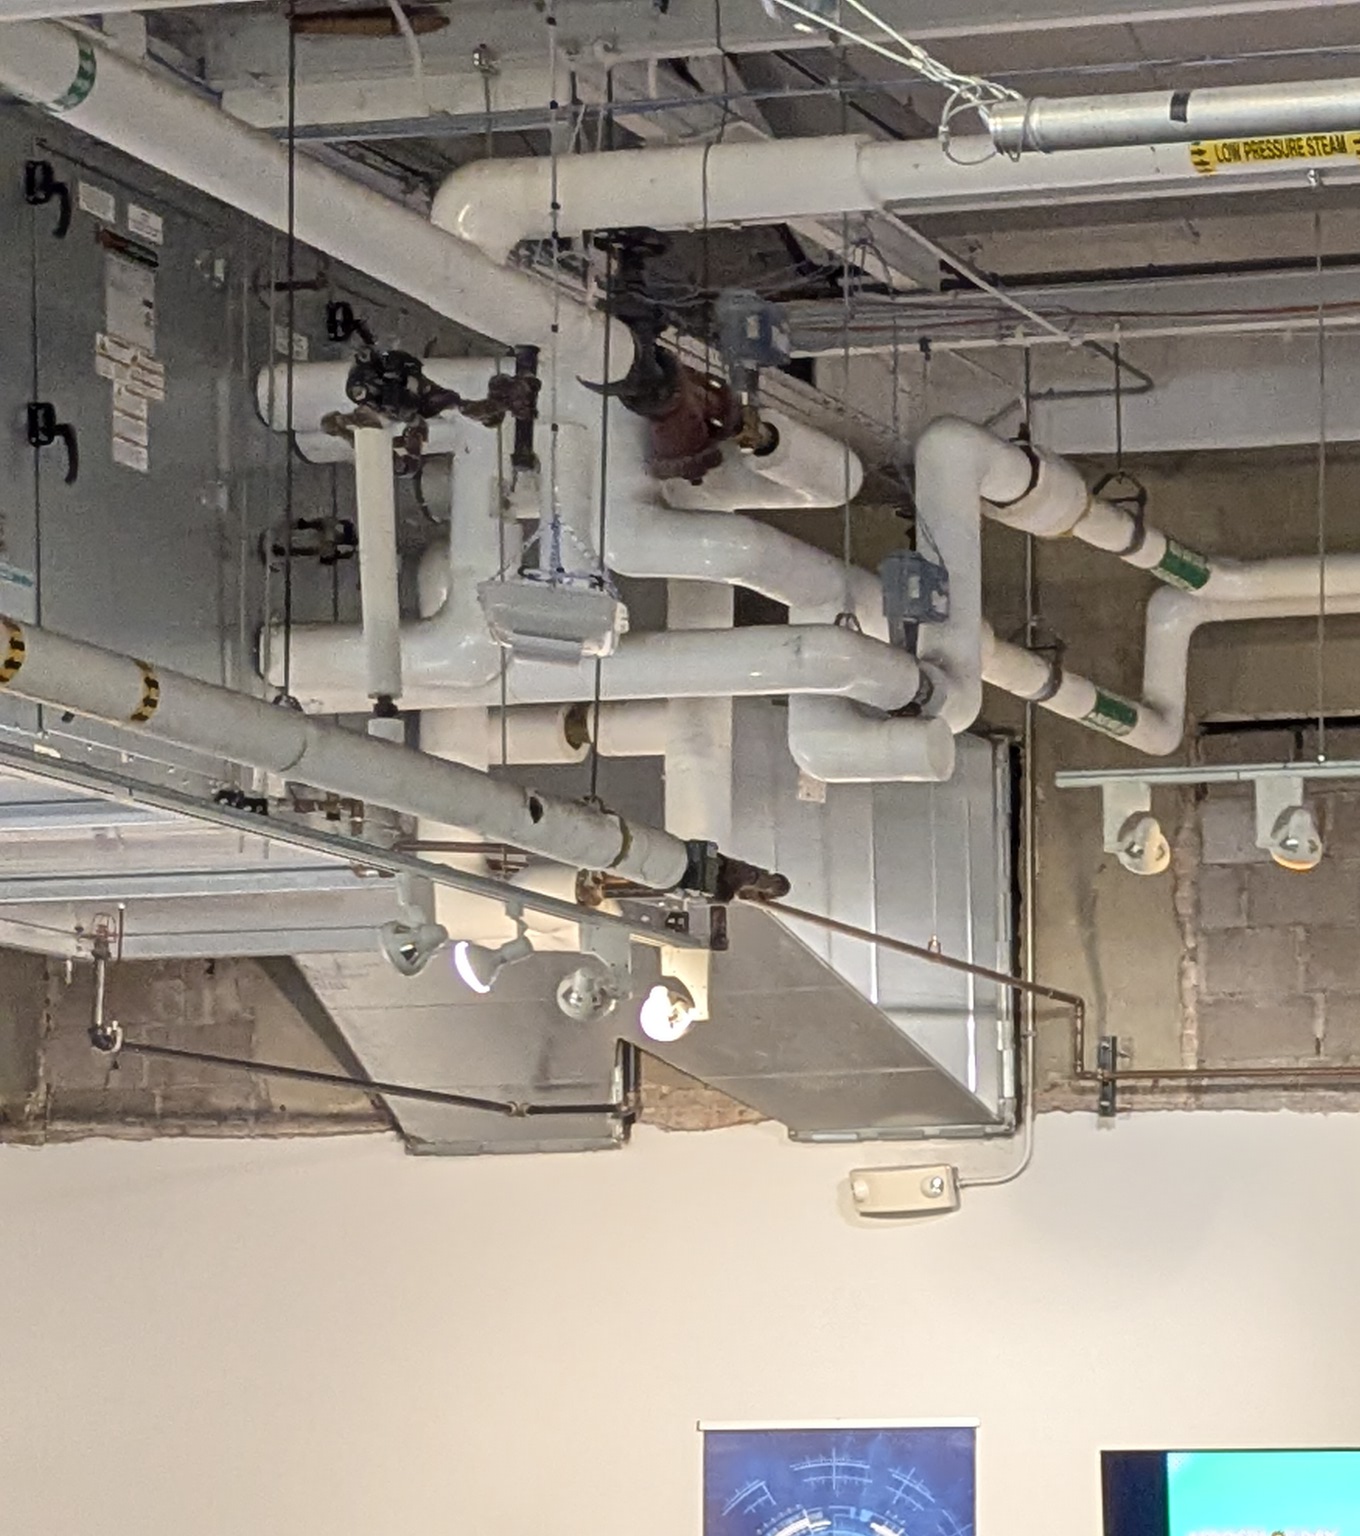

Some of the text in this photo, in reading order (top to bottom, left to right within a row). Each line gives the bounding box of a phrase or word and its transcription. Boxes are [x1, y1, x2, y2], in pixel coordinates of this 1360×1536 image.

[1214, 134, 1348, 163] LOW PRESSURE STEAM
